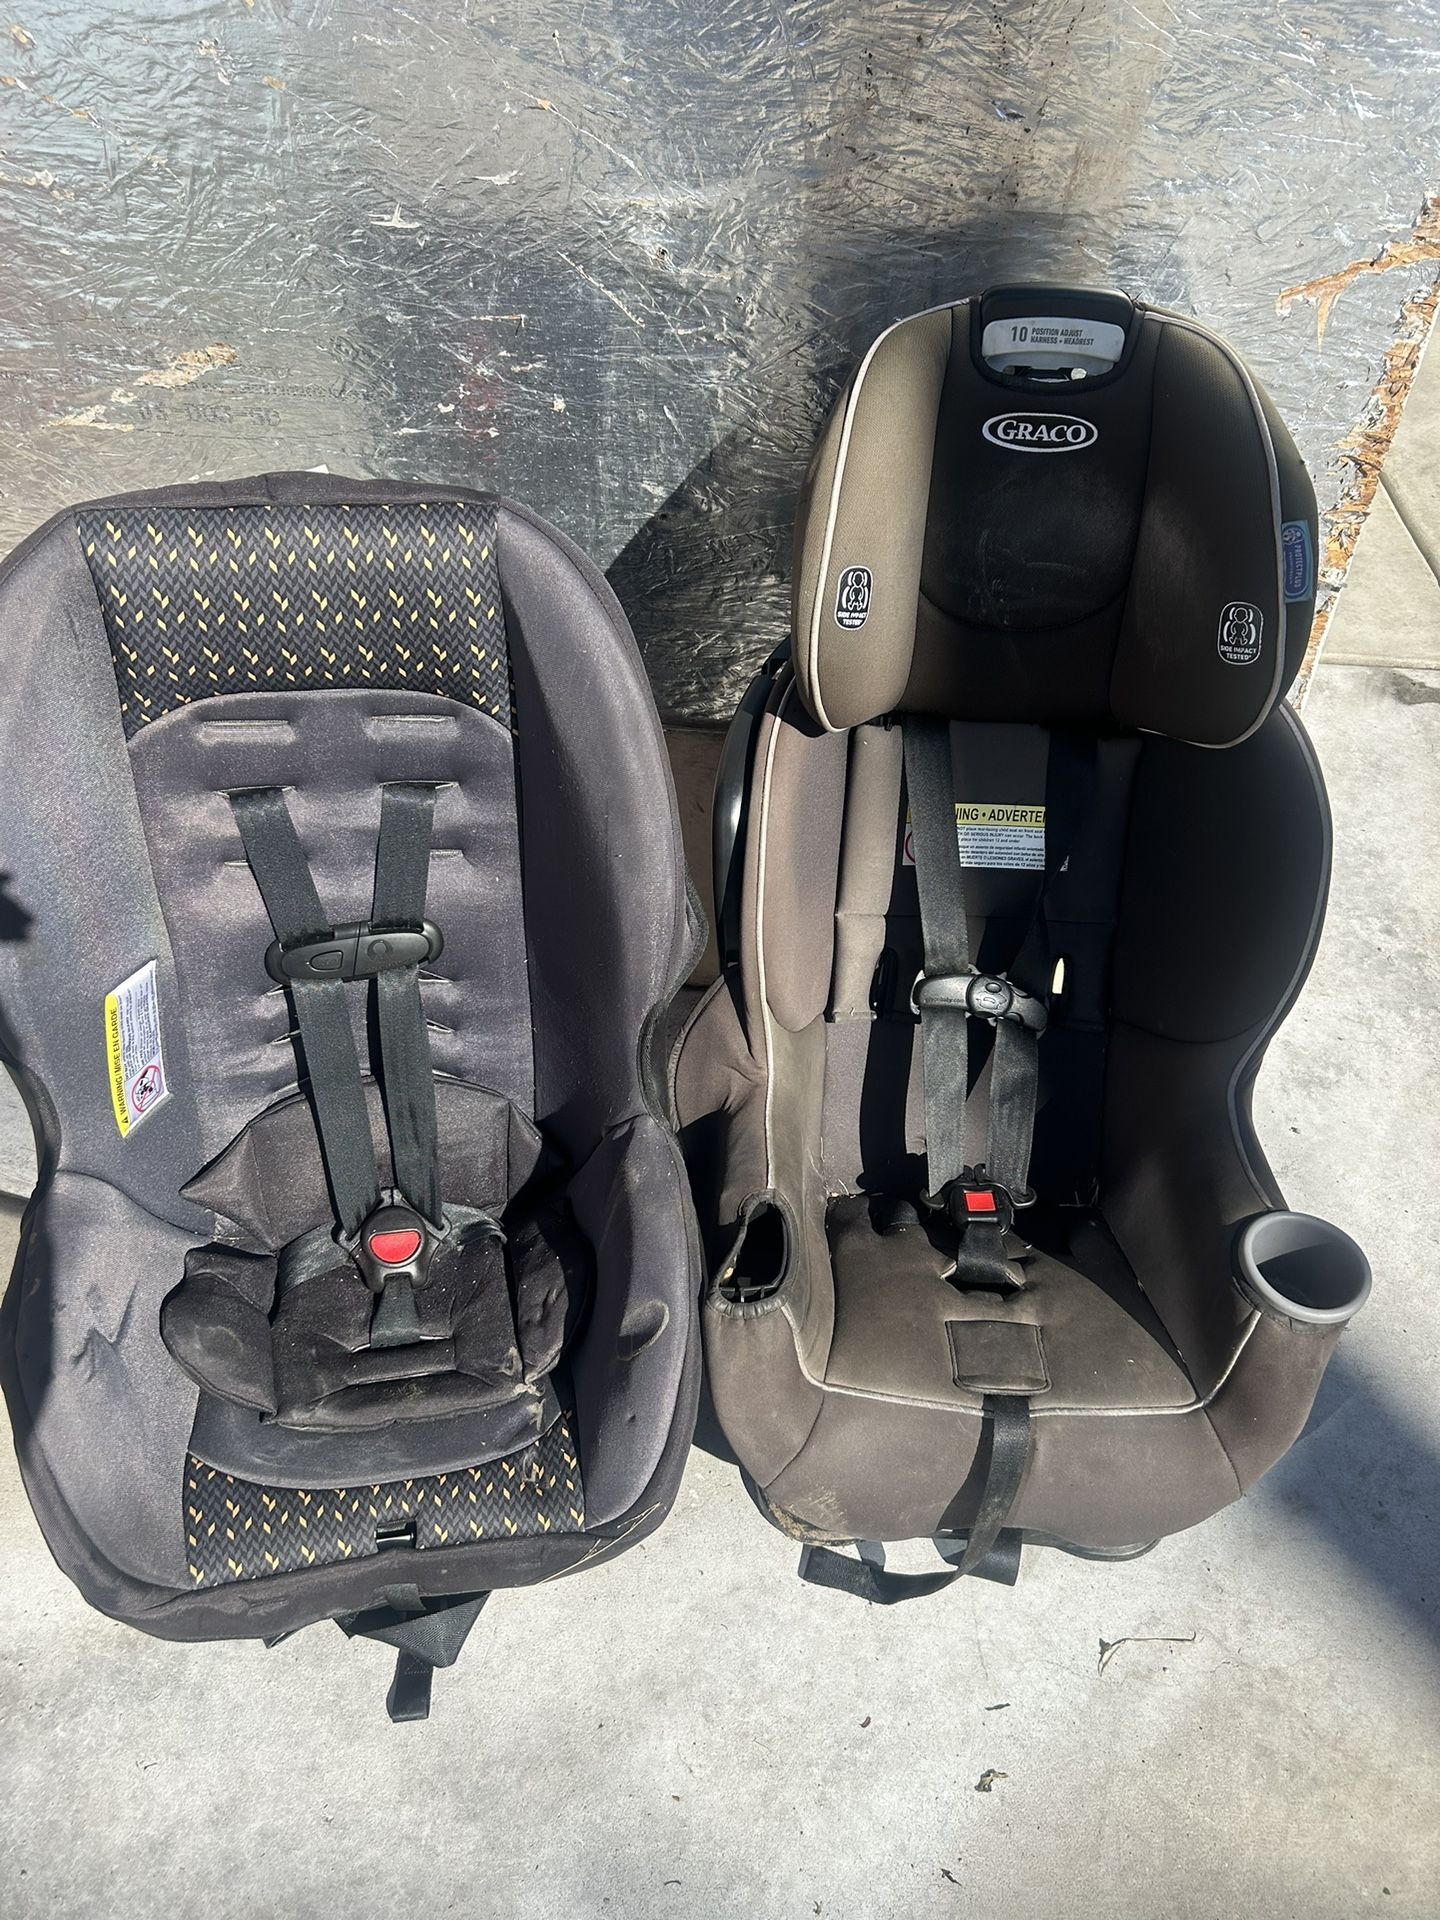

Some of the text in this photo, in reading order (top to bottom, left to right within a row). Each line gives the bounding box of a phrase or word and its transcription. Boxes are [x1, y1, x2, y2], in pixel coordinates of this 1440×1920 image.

[1011, 326, 1028, 342] 10
[1032, 327, 1082, 337] POSITION ADJUST
[1030, 336, 1095, 346] HARNESS HEADREST
[997, 420, 1087, 443] GRACO
[988, 808, 1045, 823] ADVERTE
[110, 1008, 119, 1039] GARDE
[112, 1040, 120, 1053] EN
[113, 1053, 122, 1073] MISE
[116, 1076, 126, 1115] WARNING
